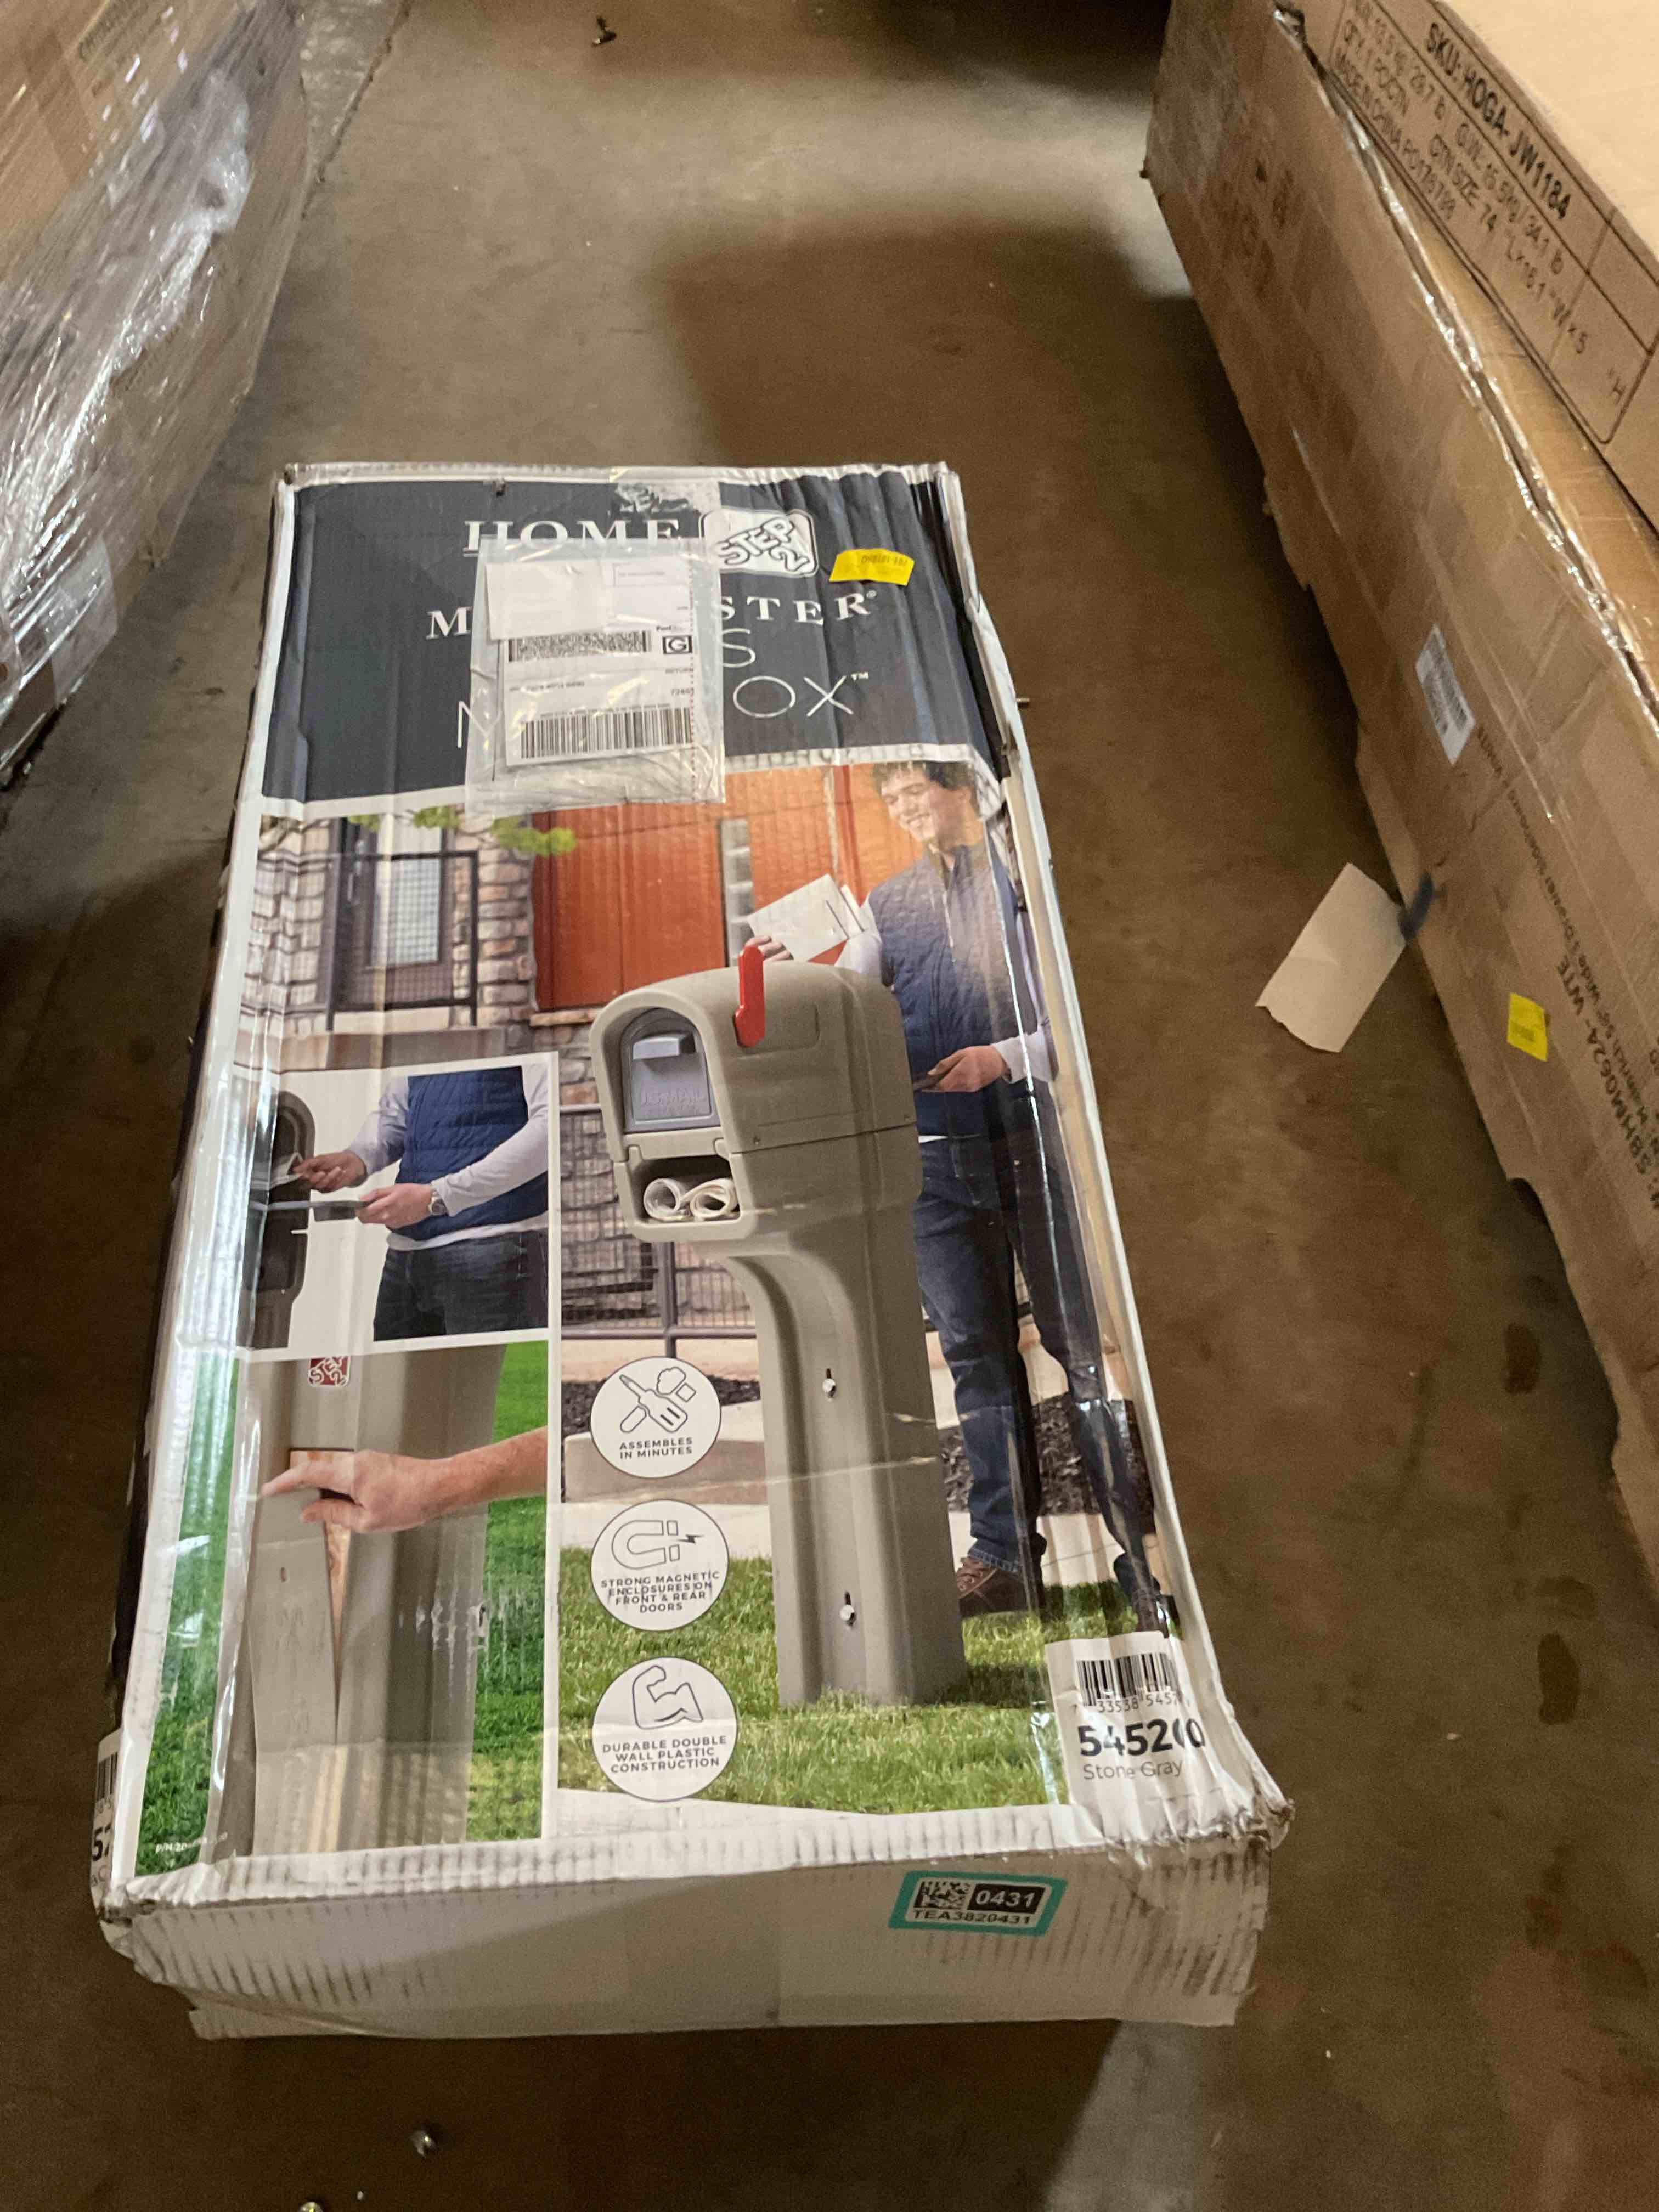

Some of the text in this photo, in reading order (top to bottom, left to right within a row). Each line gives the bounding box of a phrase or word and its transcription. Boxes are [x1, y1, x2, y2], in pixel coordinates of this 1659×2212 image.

[462, 519, 680, 557] HOME
[619, 1437, 693, 1450] ASSEMBLES
[637, 1446, 693, 1458] MINUTES
[601, 1571, 720, 1588] STRONG MAGNETIC
[608, 1581, 712, 1597] ENCLOSURES ON
[616, 1592, 706, 1605] FRONT & REAR
[640, 1602, 683, 1613] DOORS
[603, 1735, 727, 1753] DURABLE DOUBLE
[615, 1747, 715, 1762] WALL PLASTIC
[611, 1757, 720, 1773] CONSTRUCTION
[1083, 1760, 1183, 1780] Stone Gray
[975, 1889, 1036, 1907] 0431
[913, 1909, 1031, 1925] TEA3820431
